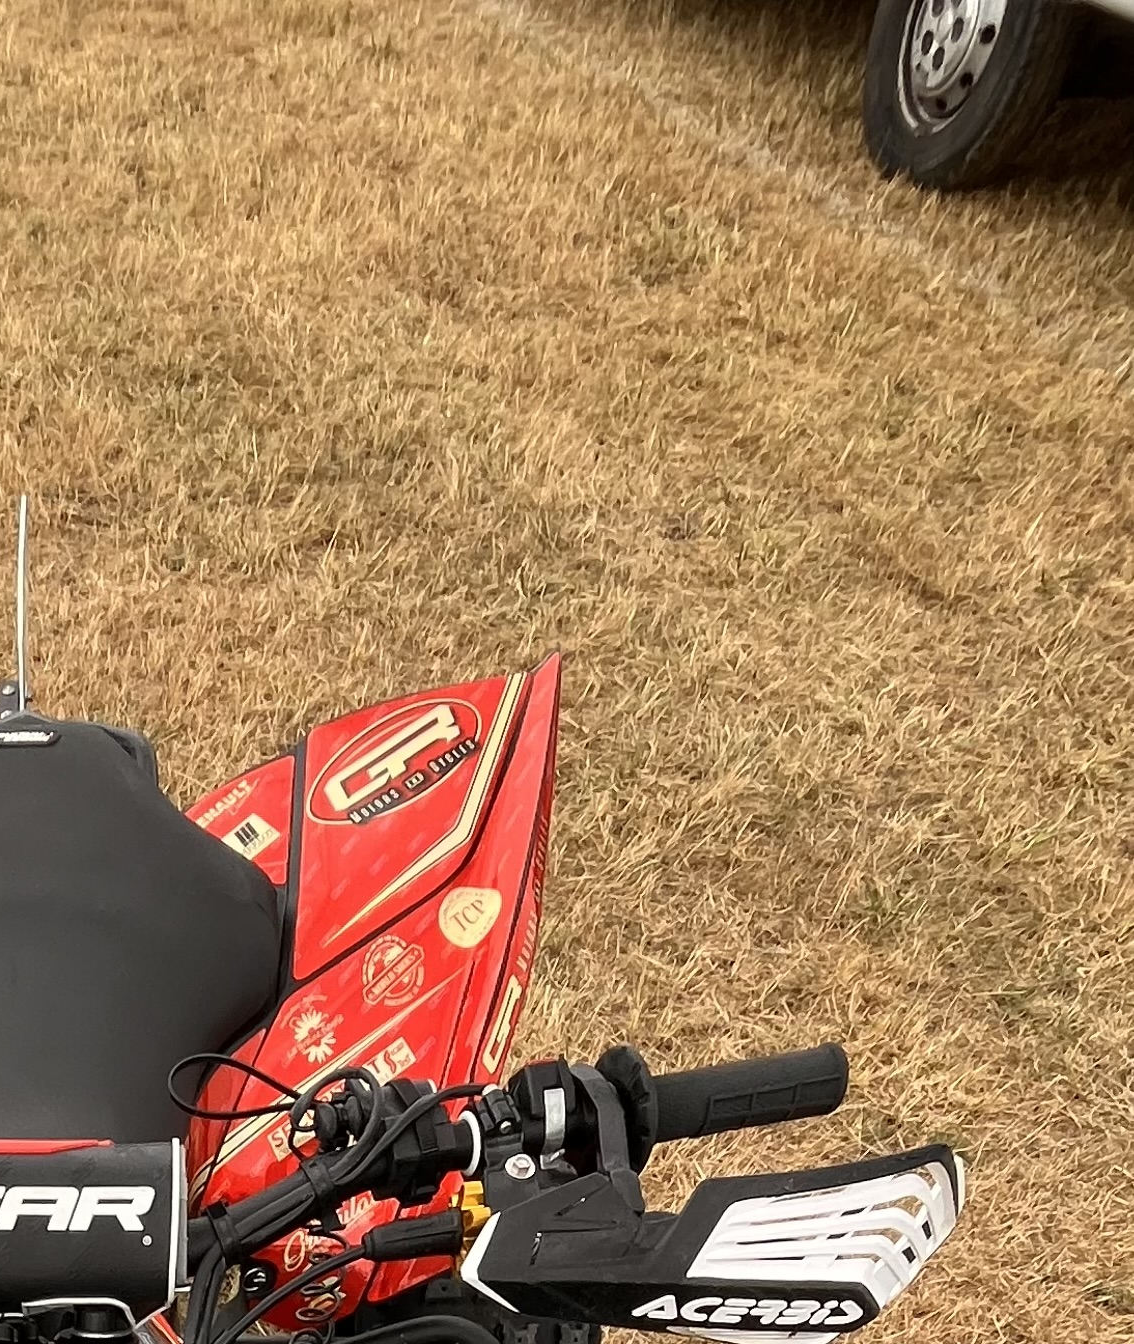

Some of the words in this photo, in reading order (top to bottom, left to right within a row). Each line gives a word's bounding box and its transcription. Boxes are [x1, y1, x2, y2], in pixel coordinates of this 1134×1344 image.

[349, 788, 400, 824] MOTORS
[449, 899, 486, 932] TCP
[631, 1294, 864, 1326] ACERBIS
